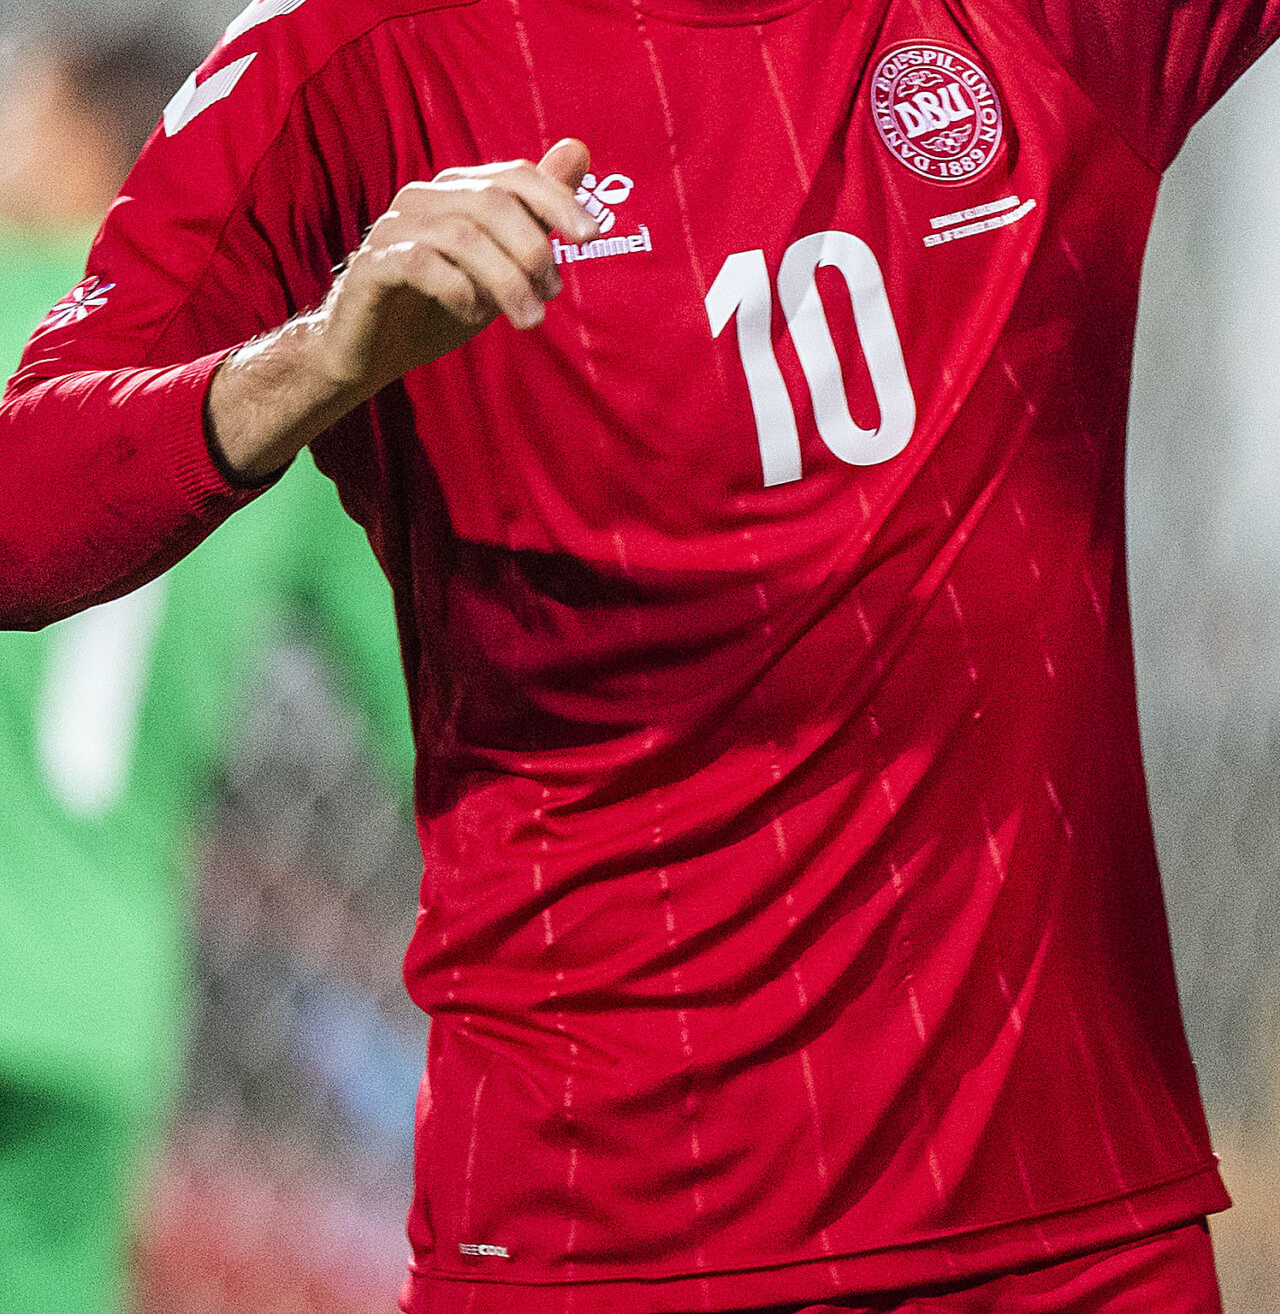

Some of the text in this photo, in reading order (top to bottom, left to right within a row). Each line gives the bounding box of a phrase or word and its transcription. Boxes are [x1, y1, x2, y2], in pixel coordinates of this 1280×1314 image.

[894, 82, 975, 139] DBU
[937, 148, 986, 176] 1889
[552, 224, 652, 264] hummel
[704, 229, 917, 488] 10
